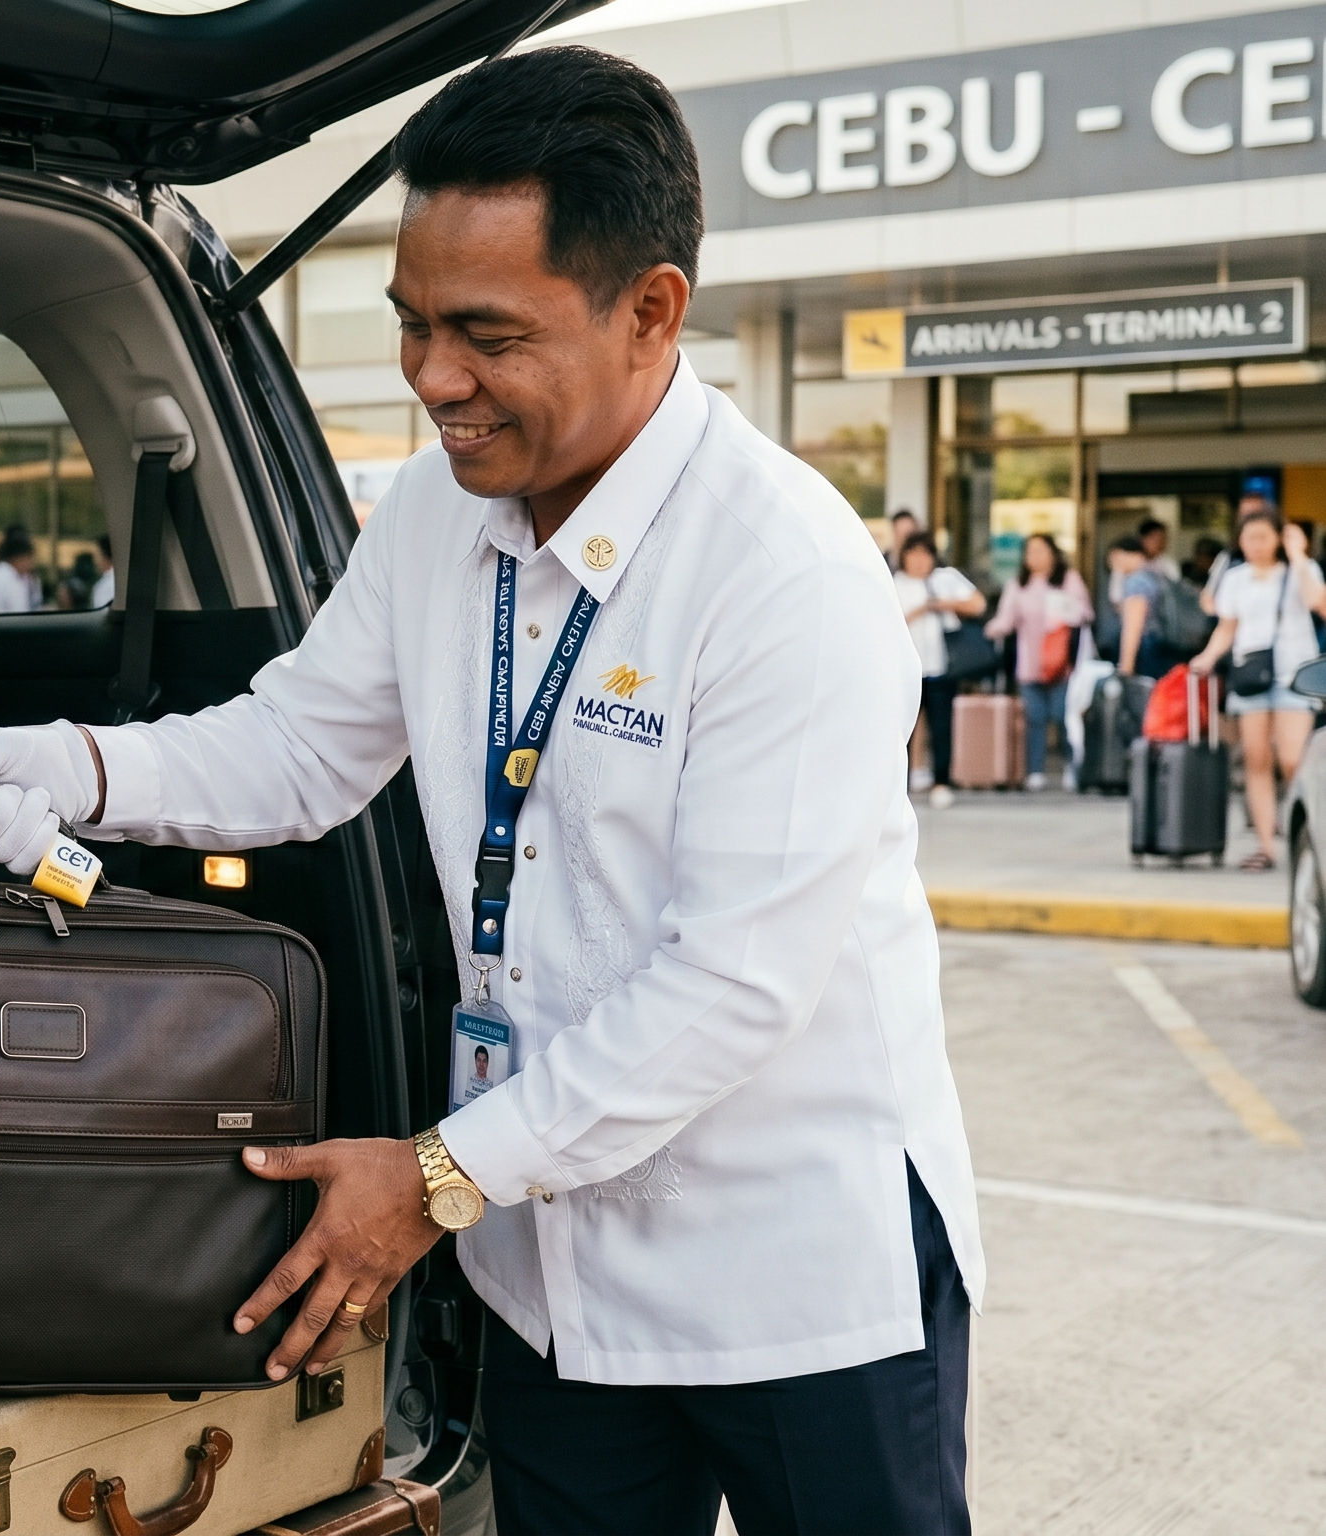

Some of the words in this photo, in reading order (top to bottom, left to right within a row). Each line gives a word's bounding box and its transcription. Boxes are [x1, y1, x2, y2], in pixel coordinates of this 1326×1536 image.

[741, 71, 1044, 199] CEBU
[1076, 105, 1123, 133] -
[1150, 36, 1326, 154] CE
[911, 316, 1062, 357] ARRIVALS
[1083, 303, 1256, 346] TERMINAL
[1259, 300, 1285, 334] 2
[575, 695, 664, 737] MACTAN
